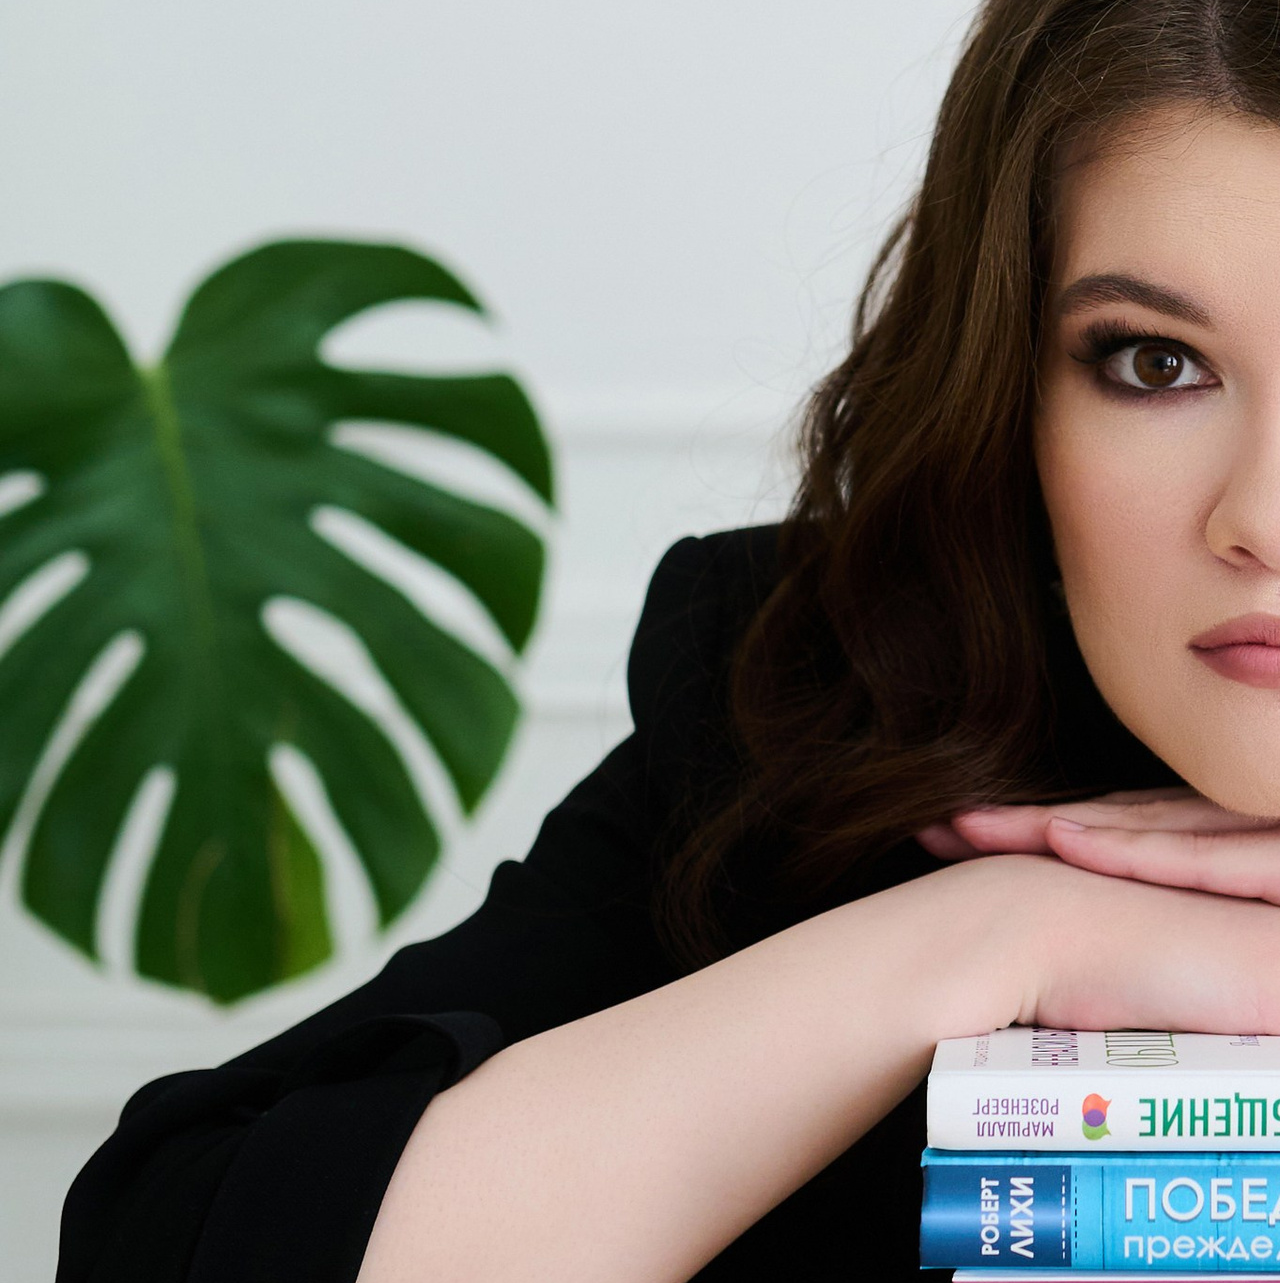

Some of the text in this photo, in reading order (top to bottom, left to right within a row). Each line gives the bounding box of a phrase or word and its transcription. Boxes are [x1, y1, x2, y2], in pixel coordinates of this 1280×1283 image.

[972, 1098, 1059, 1116] РОЗЕНБЕРГ
[977, 1121, 1054, 1138] МАРШАЛЛ
[980, 1176, 1000, 1257] РОБЕРТ
[1009, 1176, 1035, 1259] ЛИХИ
